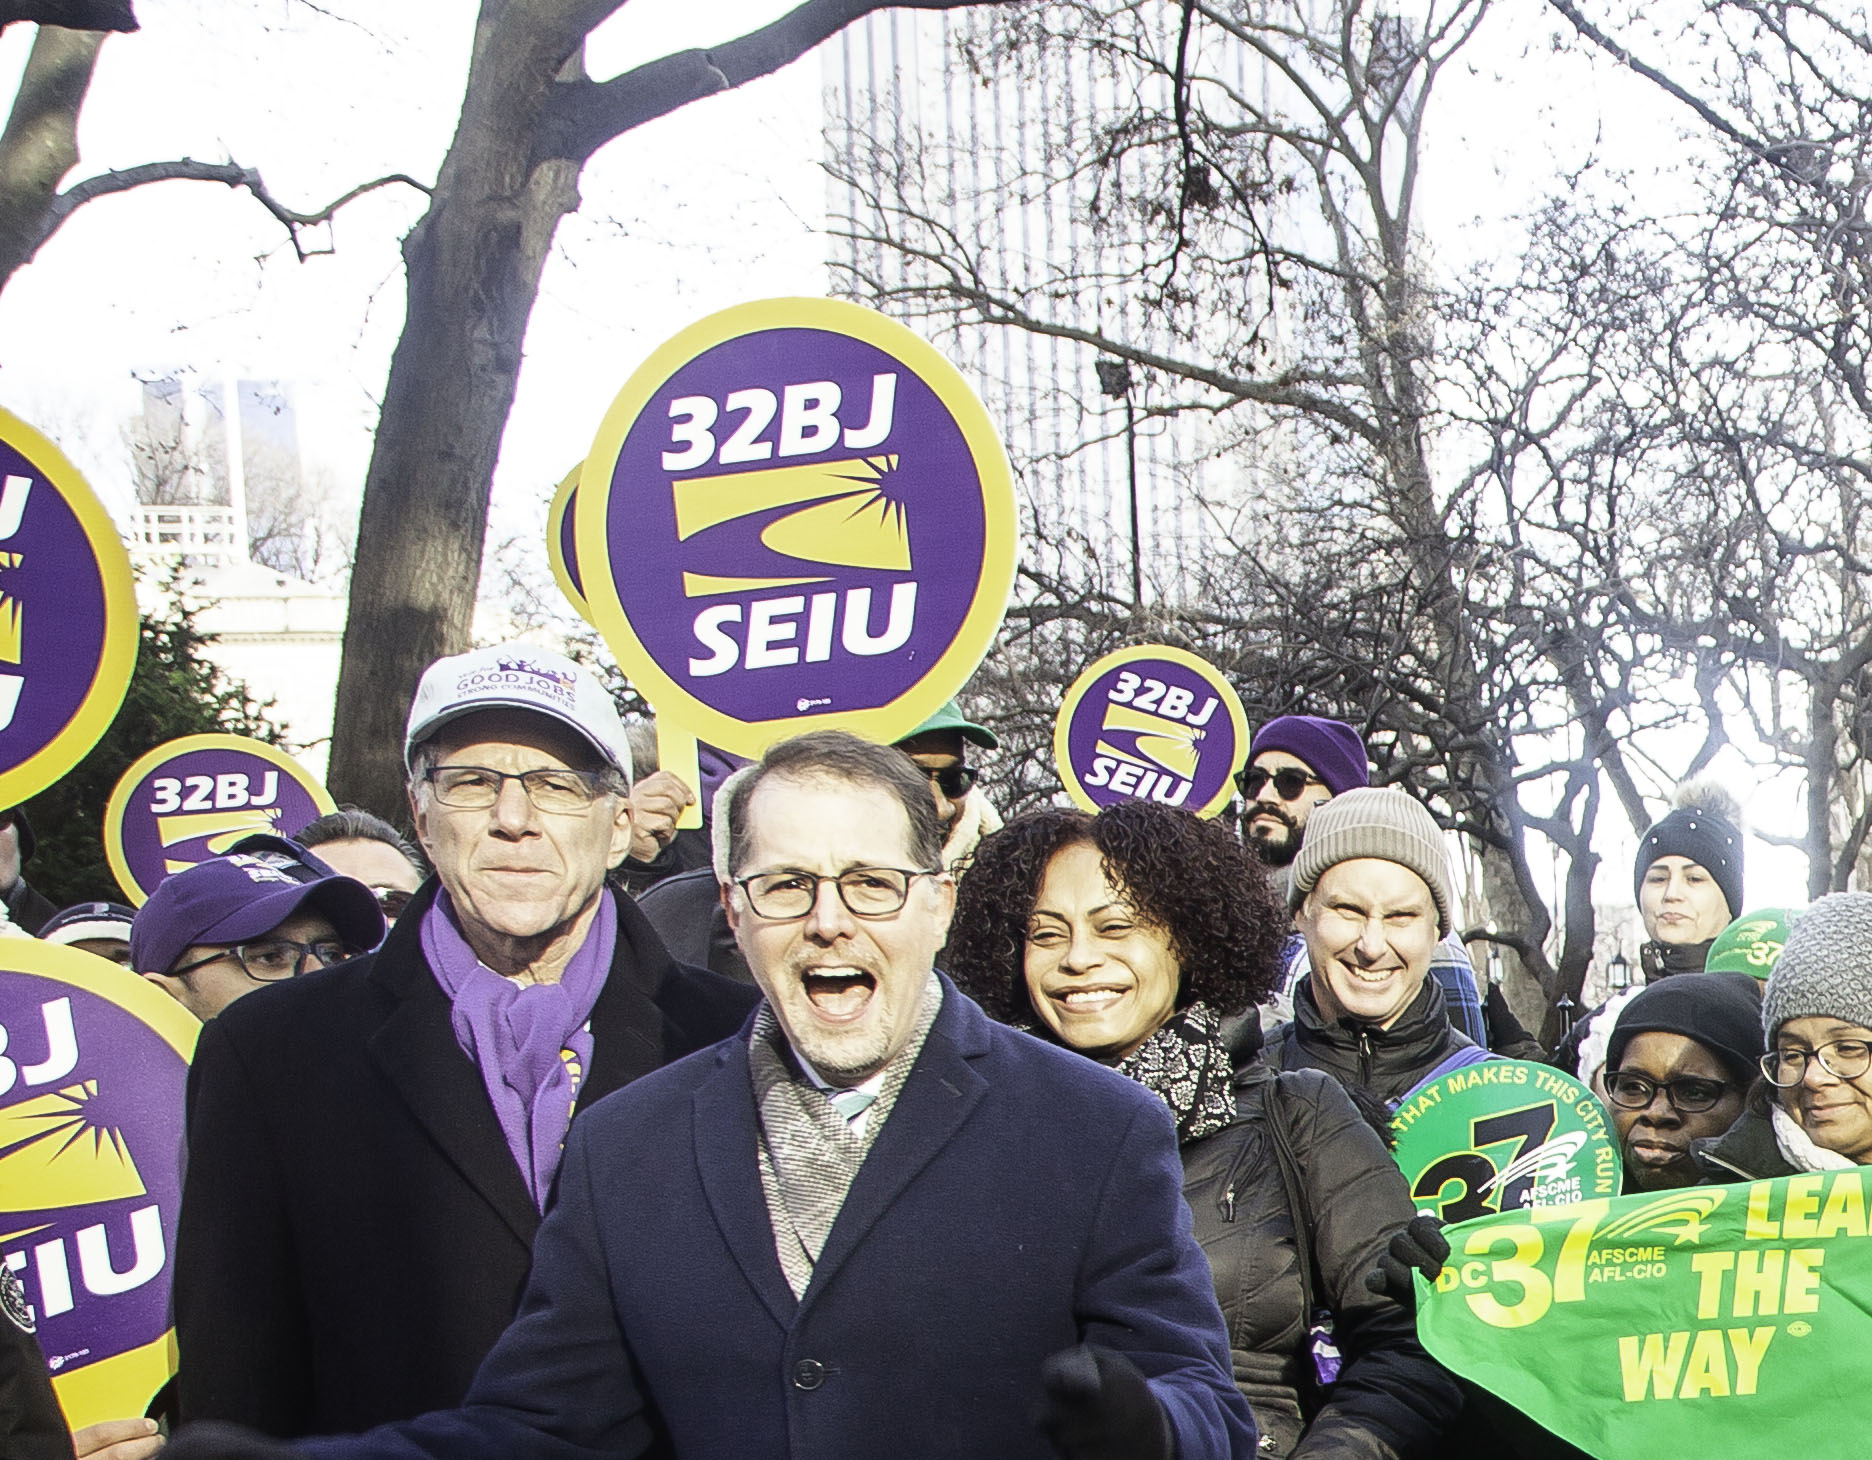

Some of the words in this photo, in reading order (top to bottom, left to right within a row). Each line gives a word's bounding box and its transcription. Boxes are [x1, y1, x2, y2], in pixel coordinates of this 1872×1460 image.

[661, 372, 897, 471] 32BJ
[688, 581, 917, 677] SEIU
[456, 673, 520, 690] GOOD
[525, 676, 576, 703] JOBS
[1107, 671, 1219, 727] 32BJ
[150, 770, 279, 813] 32BJ
[1083, 757, 1193, 807] SEIU
[1746, 941, 1784, 966] 37
[1391, 1085, 1442, 1133] THAT
[1447, 1065, 1529, 1095] MAKES
[1534, 1070, 1580, 1104] THIS
[1575, 1099, 1609, 1141] CITY
[1594, 1147, 1615, 1194] RUN
[1519, 1177, 1581, 1203] AFSCME
[1436, 1261, 1489, 1294] DC
[1464, 1202, 1610, 1329] 37
[1587, 1246, 1665, 1267] AFSCME
[1588, 1263, 1668, 1284] AFL-CIO
[1690, 1248, 1825, 1320] THE
[1618, 1325, 1777, 1403] WAY
